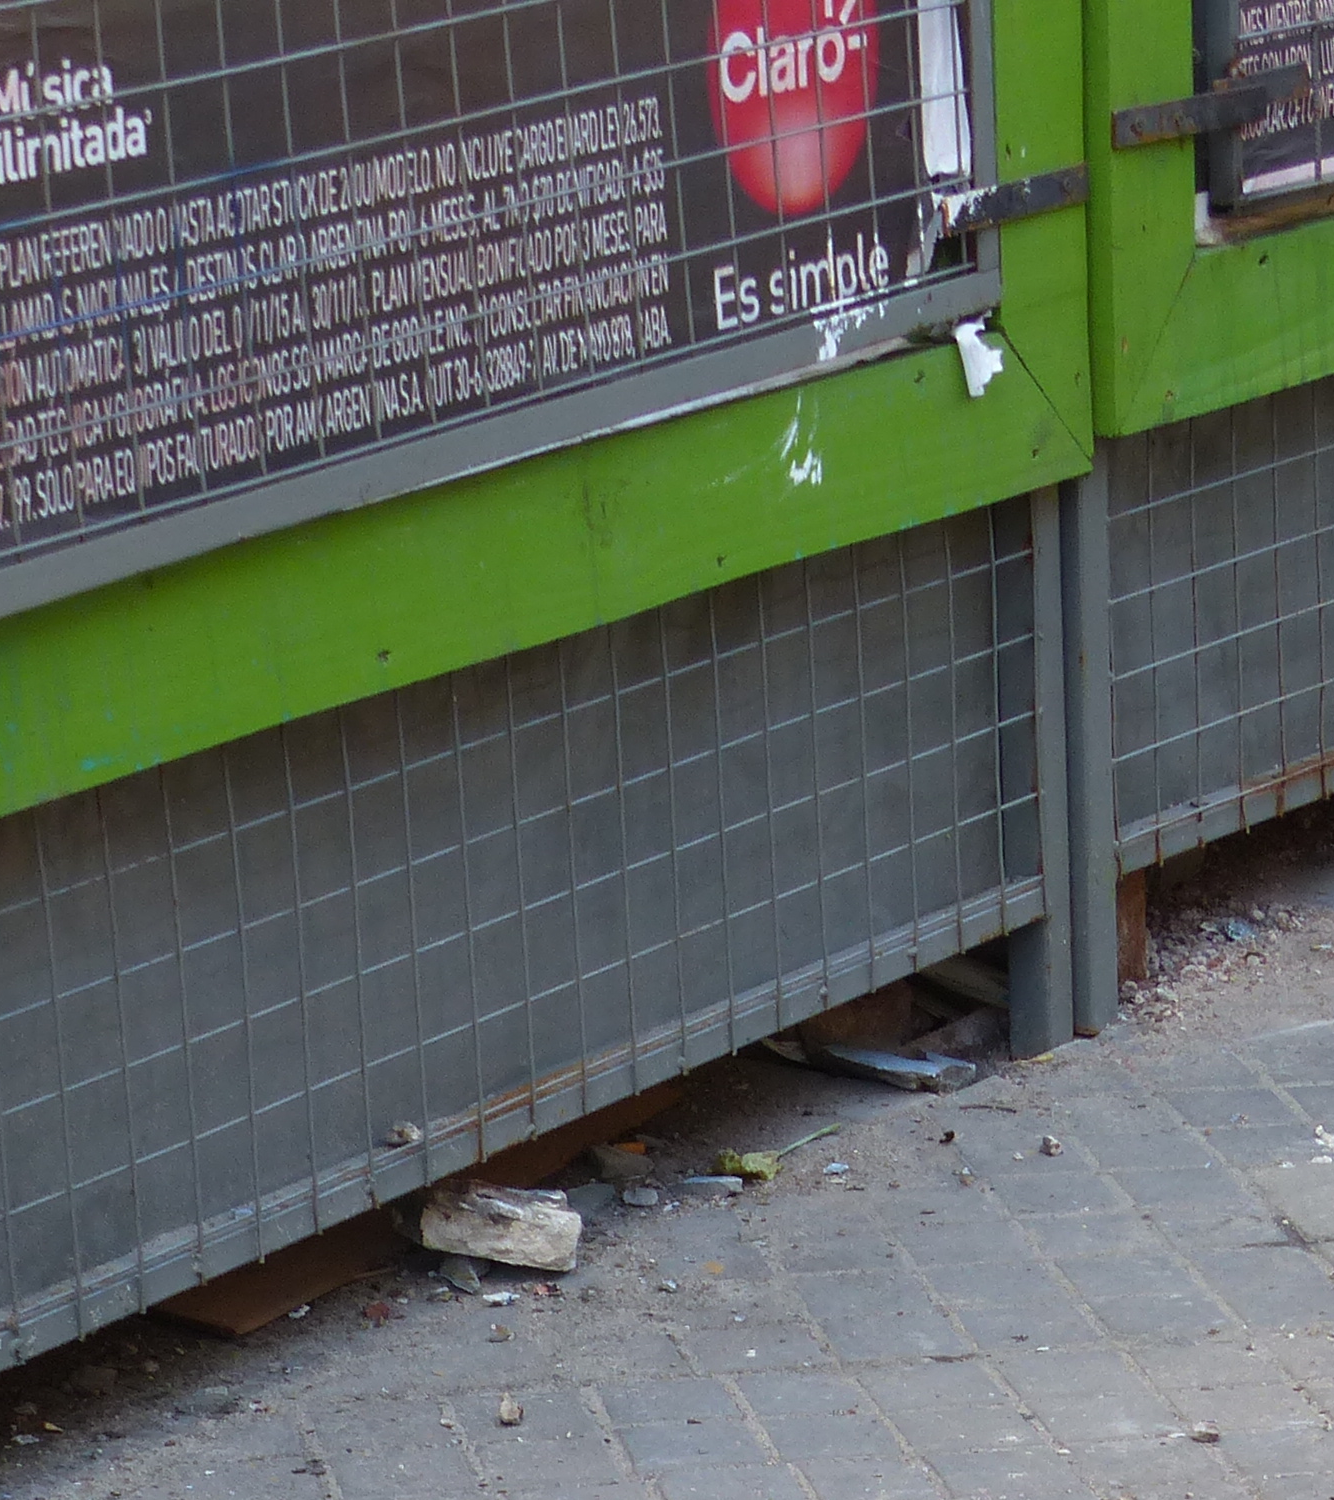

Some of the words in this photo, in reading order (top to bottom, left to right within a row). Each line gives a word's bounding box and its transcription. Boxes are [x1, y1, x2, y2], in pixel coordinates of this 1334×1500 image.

[720, 25, 845, 103] Claro
[713, 265, 760, 332] Es
[769, 231, 890, 316] simple
